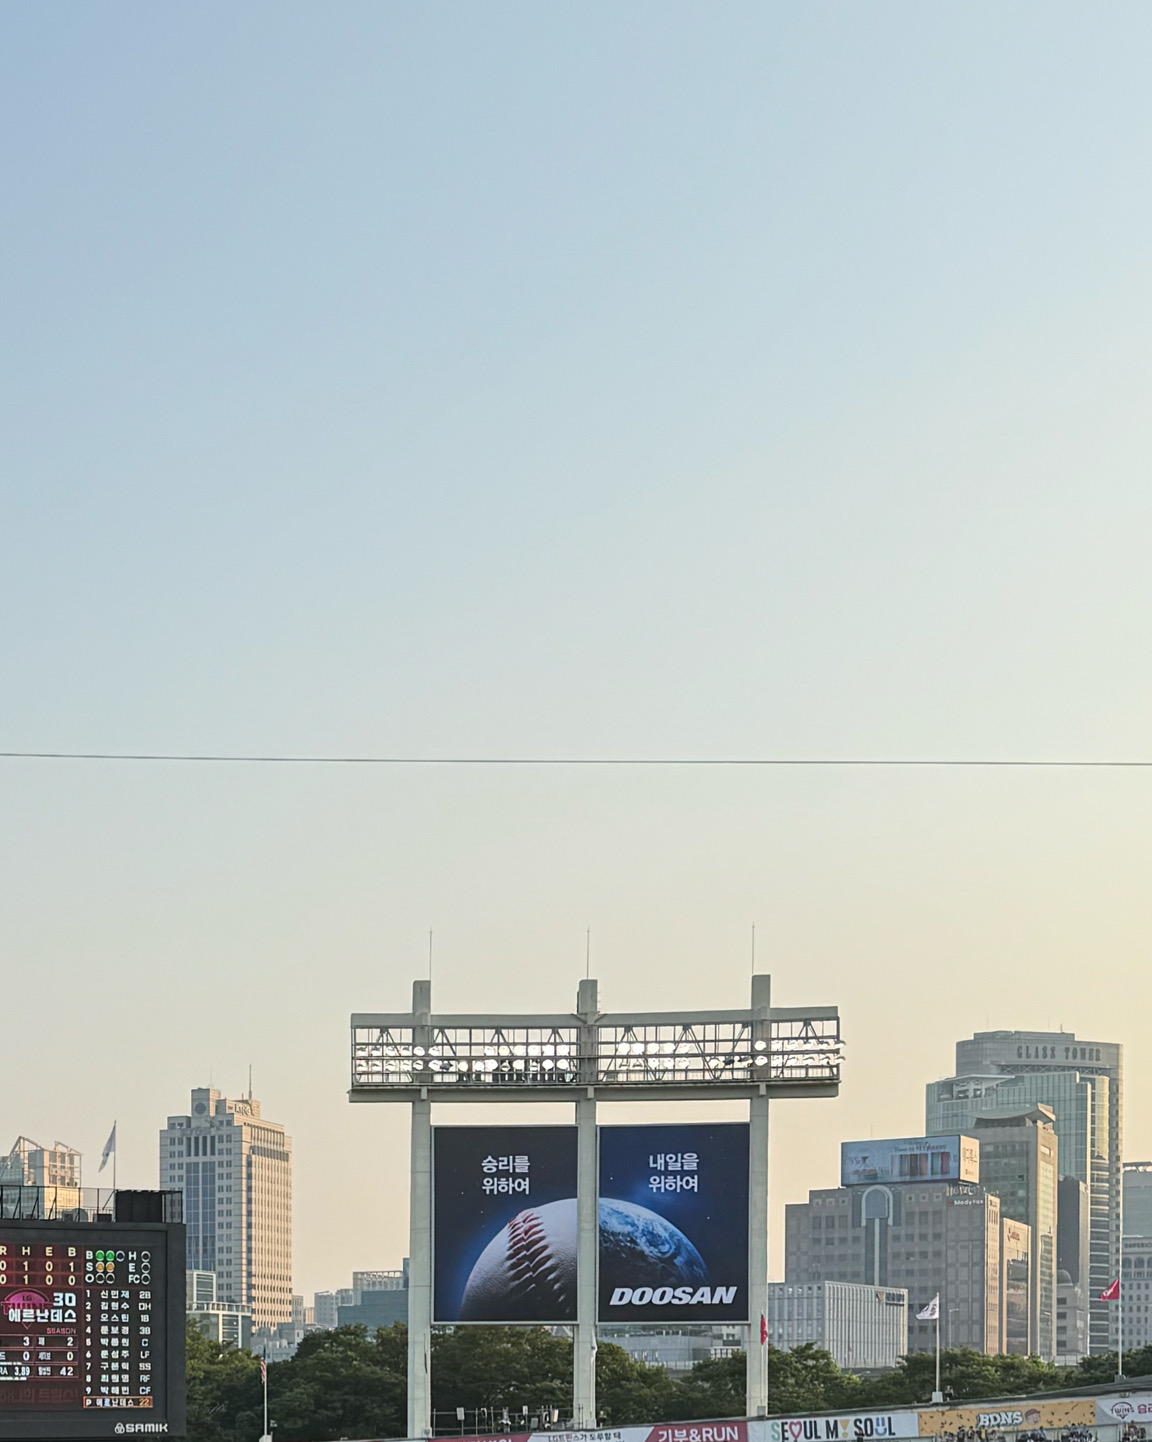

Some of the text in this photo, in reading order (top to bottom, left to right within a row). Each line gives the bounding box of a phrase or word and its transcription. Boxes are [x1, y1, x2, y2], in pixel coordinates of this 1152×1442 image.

[1017, 1045, 1101, 1061] GLASS TOWER
[481, 1155, 530, 1173] 승리를
[649, 1153, 699, 1171] 내일을
[482, 1177, 530, 1195] 위하여
[649, 1174, 699, 1193] 위하여
[0, 1246, 7, 1255] R
[22, 1246, 30, 1255] H
[45, 1247, 53, 1256] E
[68, 1247, 76, 1256] B
[86, 1250, 93, 1259] B
[129, 1251, 136, 1260] H
[0, 1260, 7, 1271] 0
[23, 1261, 28, 1271] 1
[46, 1261, 53, 1272] 0
[69, 1262, 74, 1272] 1
[86, 1262, 93, 1271] S
[129, 1263, 135, 1272] E
[0, 1274, 7, 1284] 0
[23, 1275, 28, 1284] 1
[46, 1275, 53, 1285] 0
[68, 1275, 76, 1285] 0
[129, 1274, 140, 1283] FC
[53, 1292, 76, 1307] 30
[609, 1286, 737, 1306] DOOSAN
[8, 1309, 76, 1323] 에르난데스
[86, 1314, 91, 1322] 3
[23, 1337, 30, 1346] 3
[67, 1337, 73, 1346] 2
[23, 1352, 30, 1361] 0
[67, 1352, 73, 1361] 0
[14, 1367, 30, 1376] 3.89
[60, 1367, 73, 1376] 42
[977, 1411, 1023, 1427] BDNS
[126, 1423, 168, 1433] SAMIK
